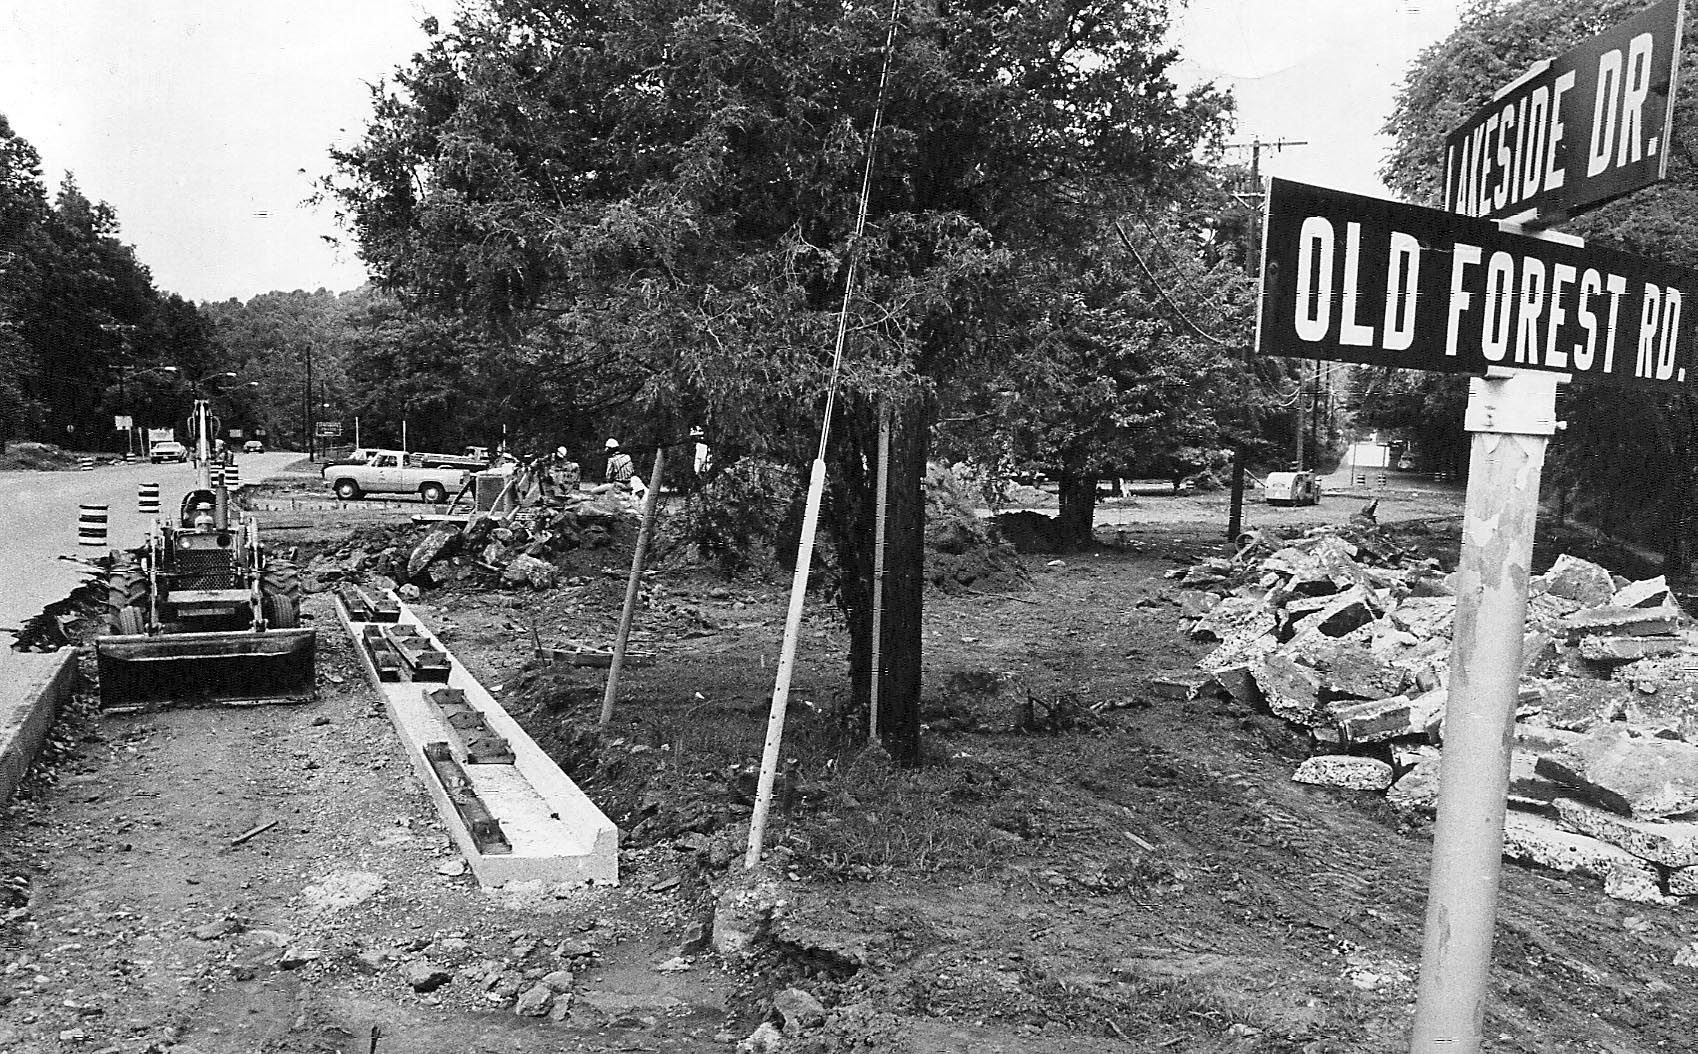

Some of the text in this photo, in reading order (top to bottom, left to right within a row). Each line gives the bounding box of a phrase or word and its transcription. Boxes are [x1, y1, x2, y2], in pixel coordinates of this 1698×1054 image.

[1444, 33, 1658, 217] LAKESIDE DR.
[1295, 216, 1685, 382] OLD FOREST RD.
